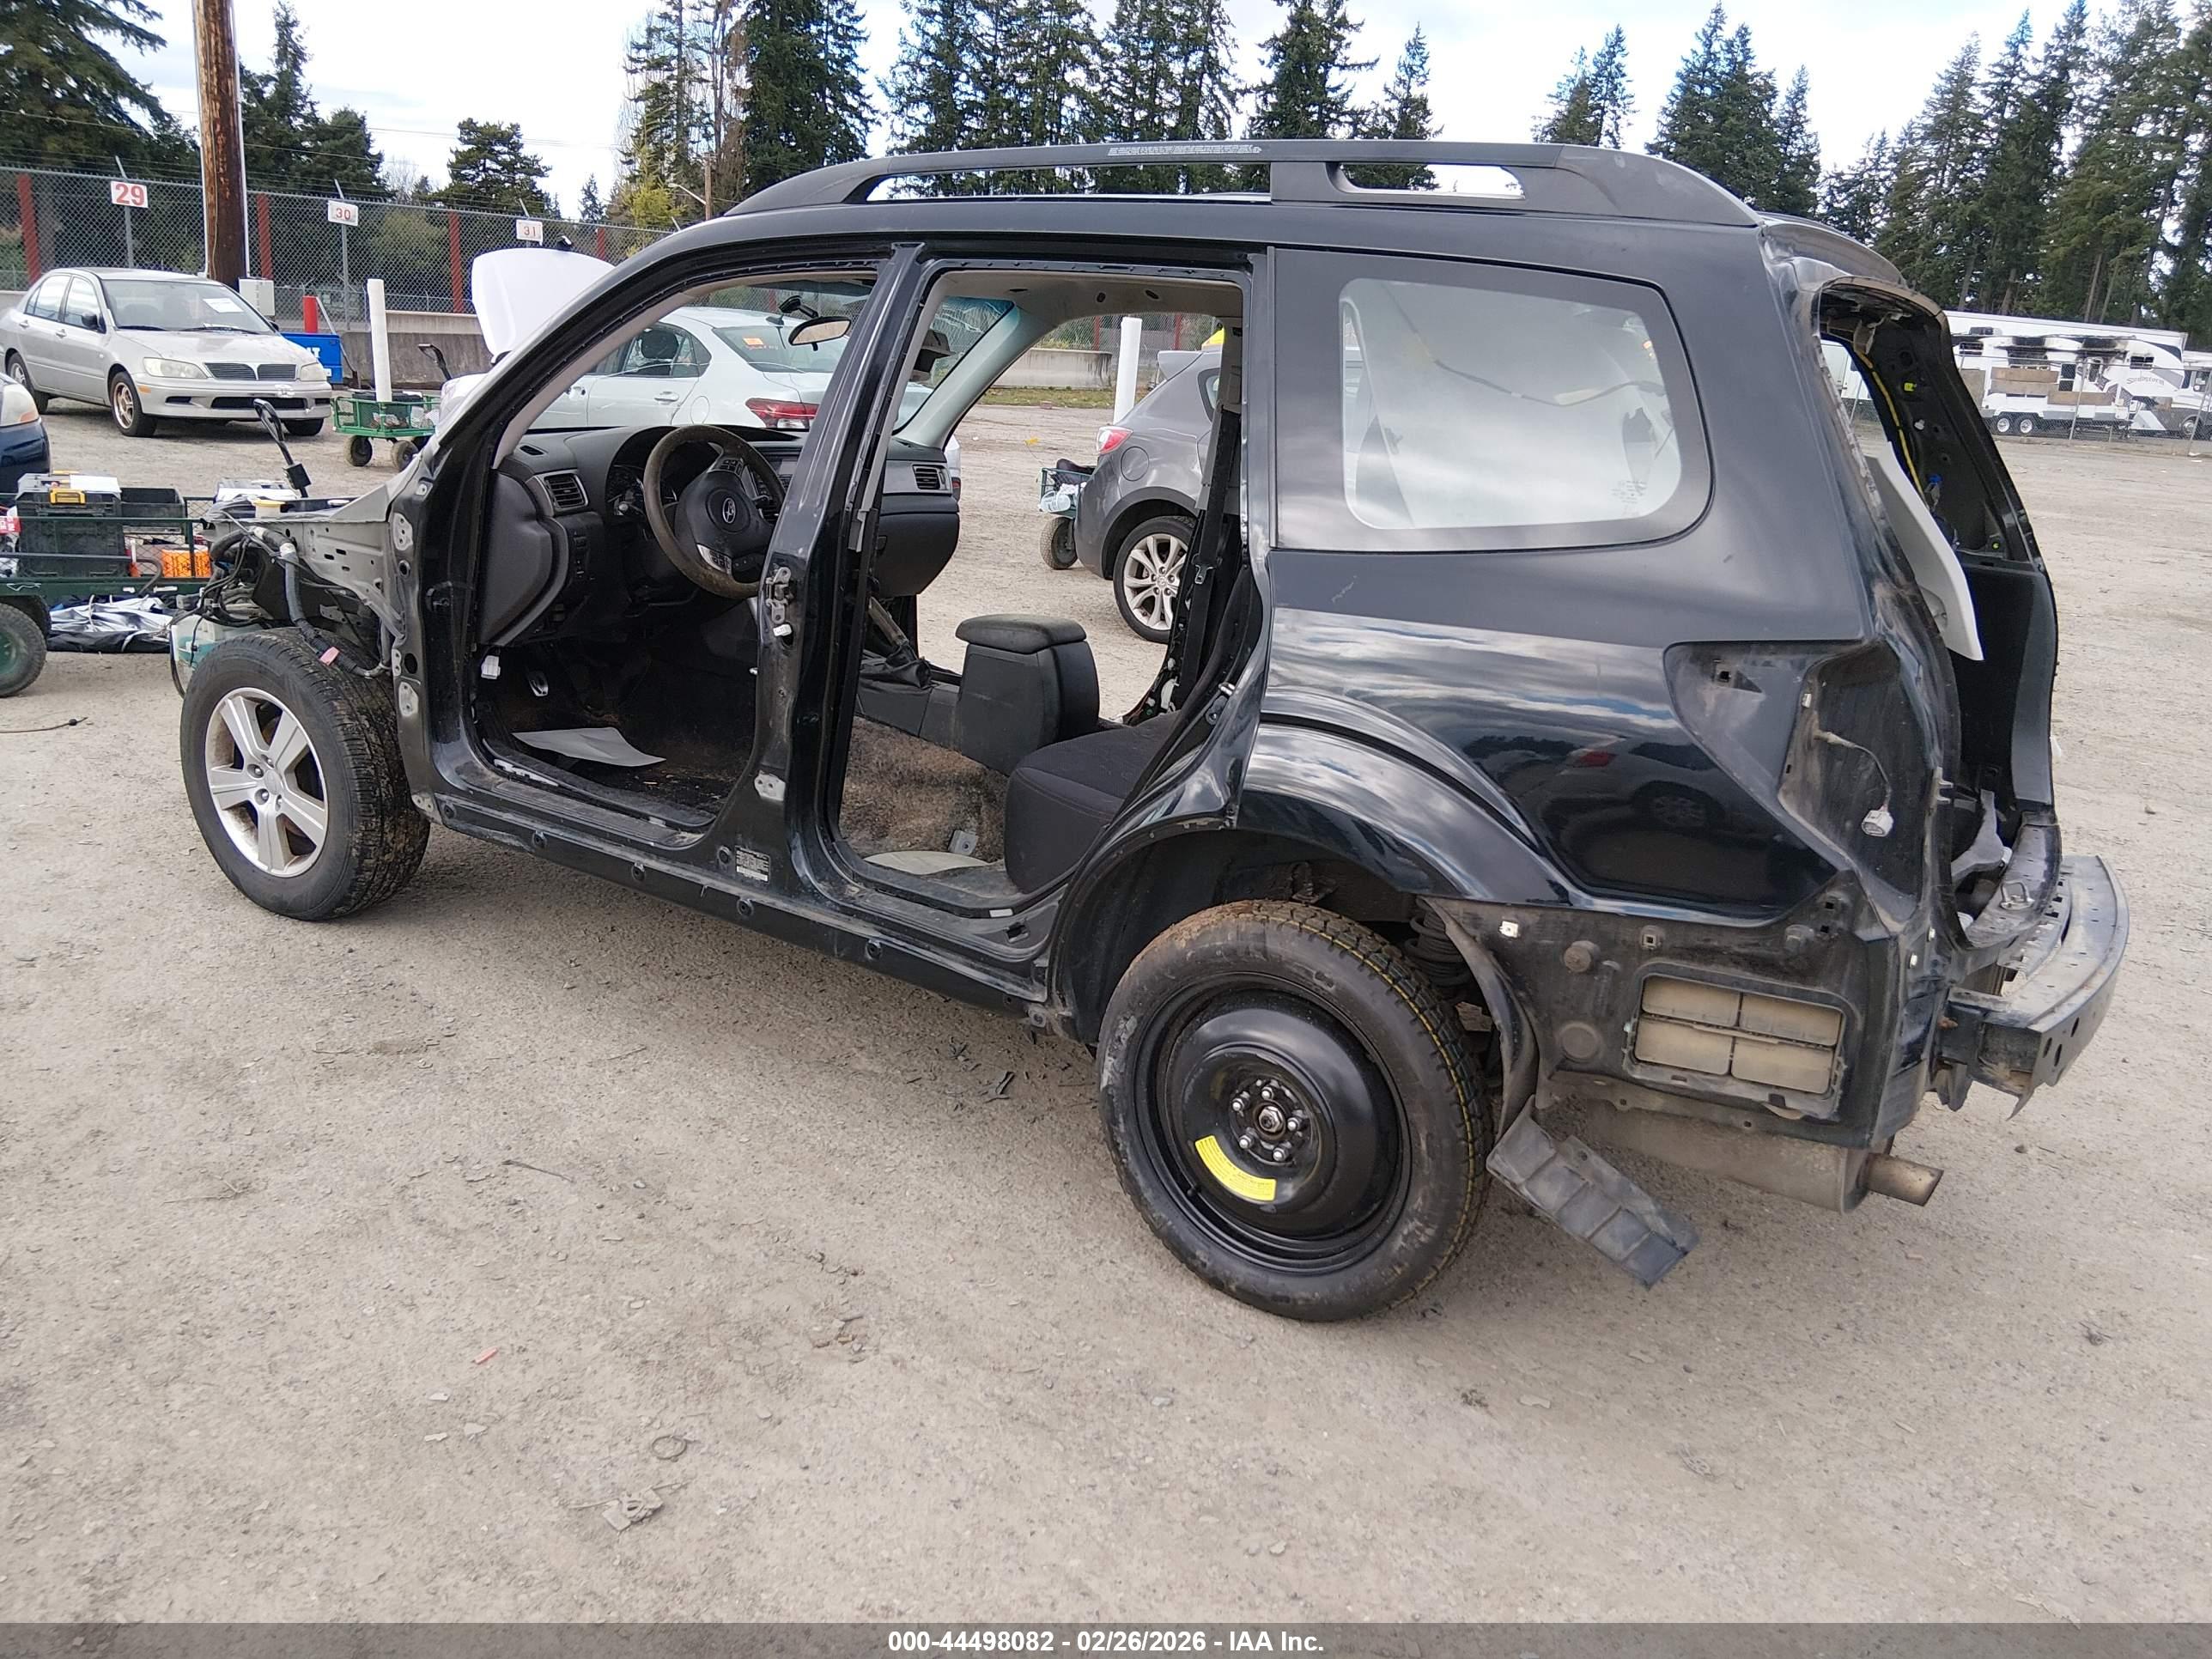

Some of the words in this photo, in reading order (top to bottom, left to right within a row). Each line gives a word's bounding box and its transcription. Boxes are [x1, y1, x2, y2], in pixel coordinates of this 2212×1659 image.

[115, 183, 145, 206] 29
[337, 207, 351, 221] 30
[523, 226, 536, 237] 31
